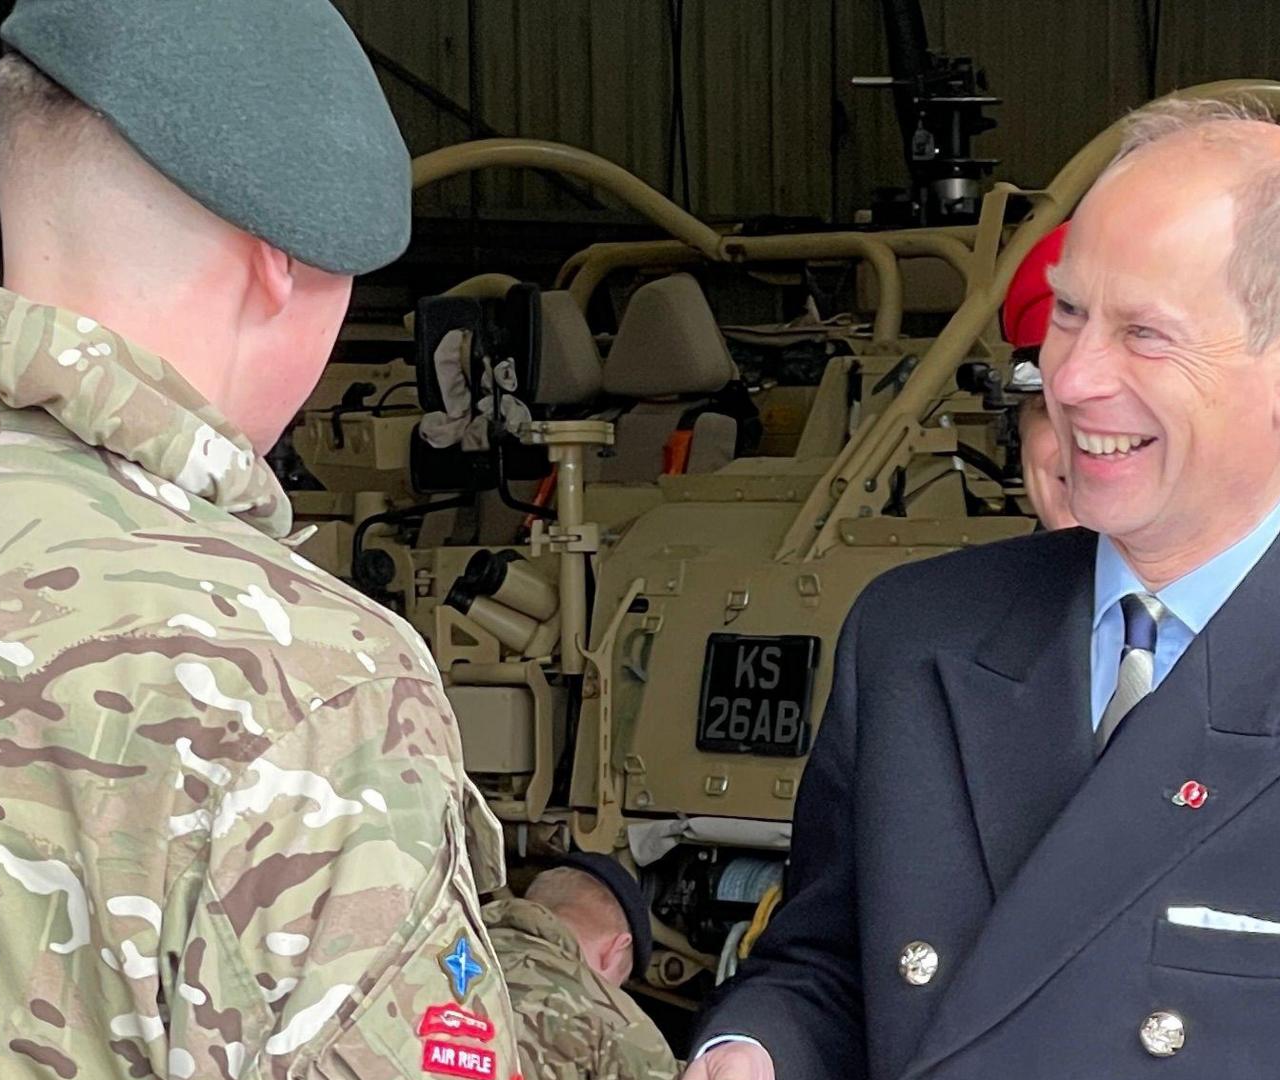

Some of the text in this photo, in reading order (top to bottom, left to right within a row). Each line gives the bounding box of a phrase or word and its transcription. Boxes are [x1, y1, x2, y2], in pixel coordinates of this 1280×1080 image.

[735, 645, 782, 690] KS
[705, 696, 800, 743] 26AB
[431, 1046, 492, 1074] AIR RIFLE
